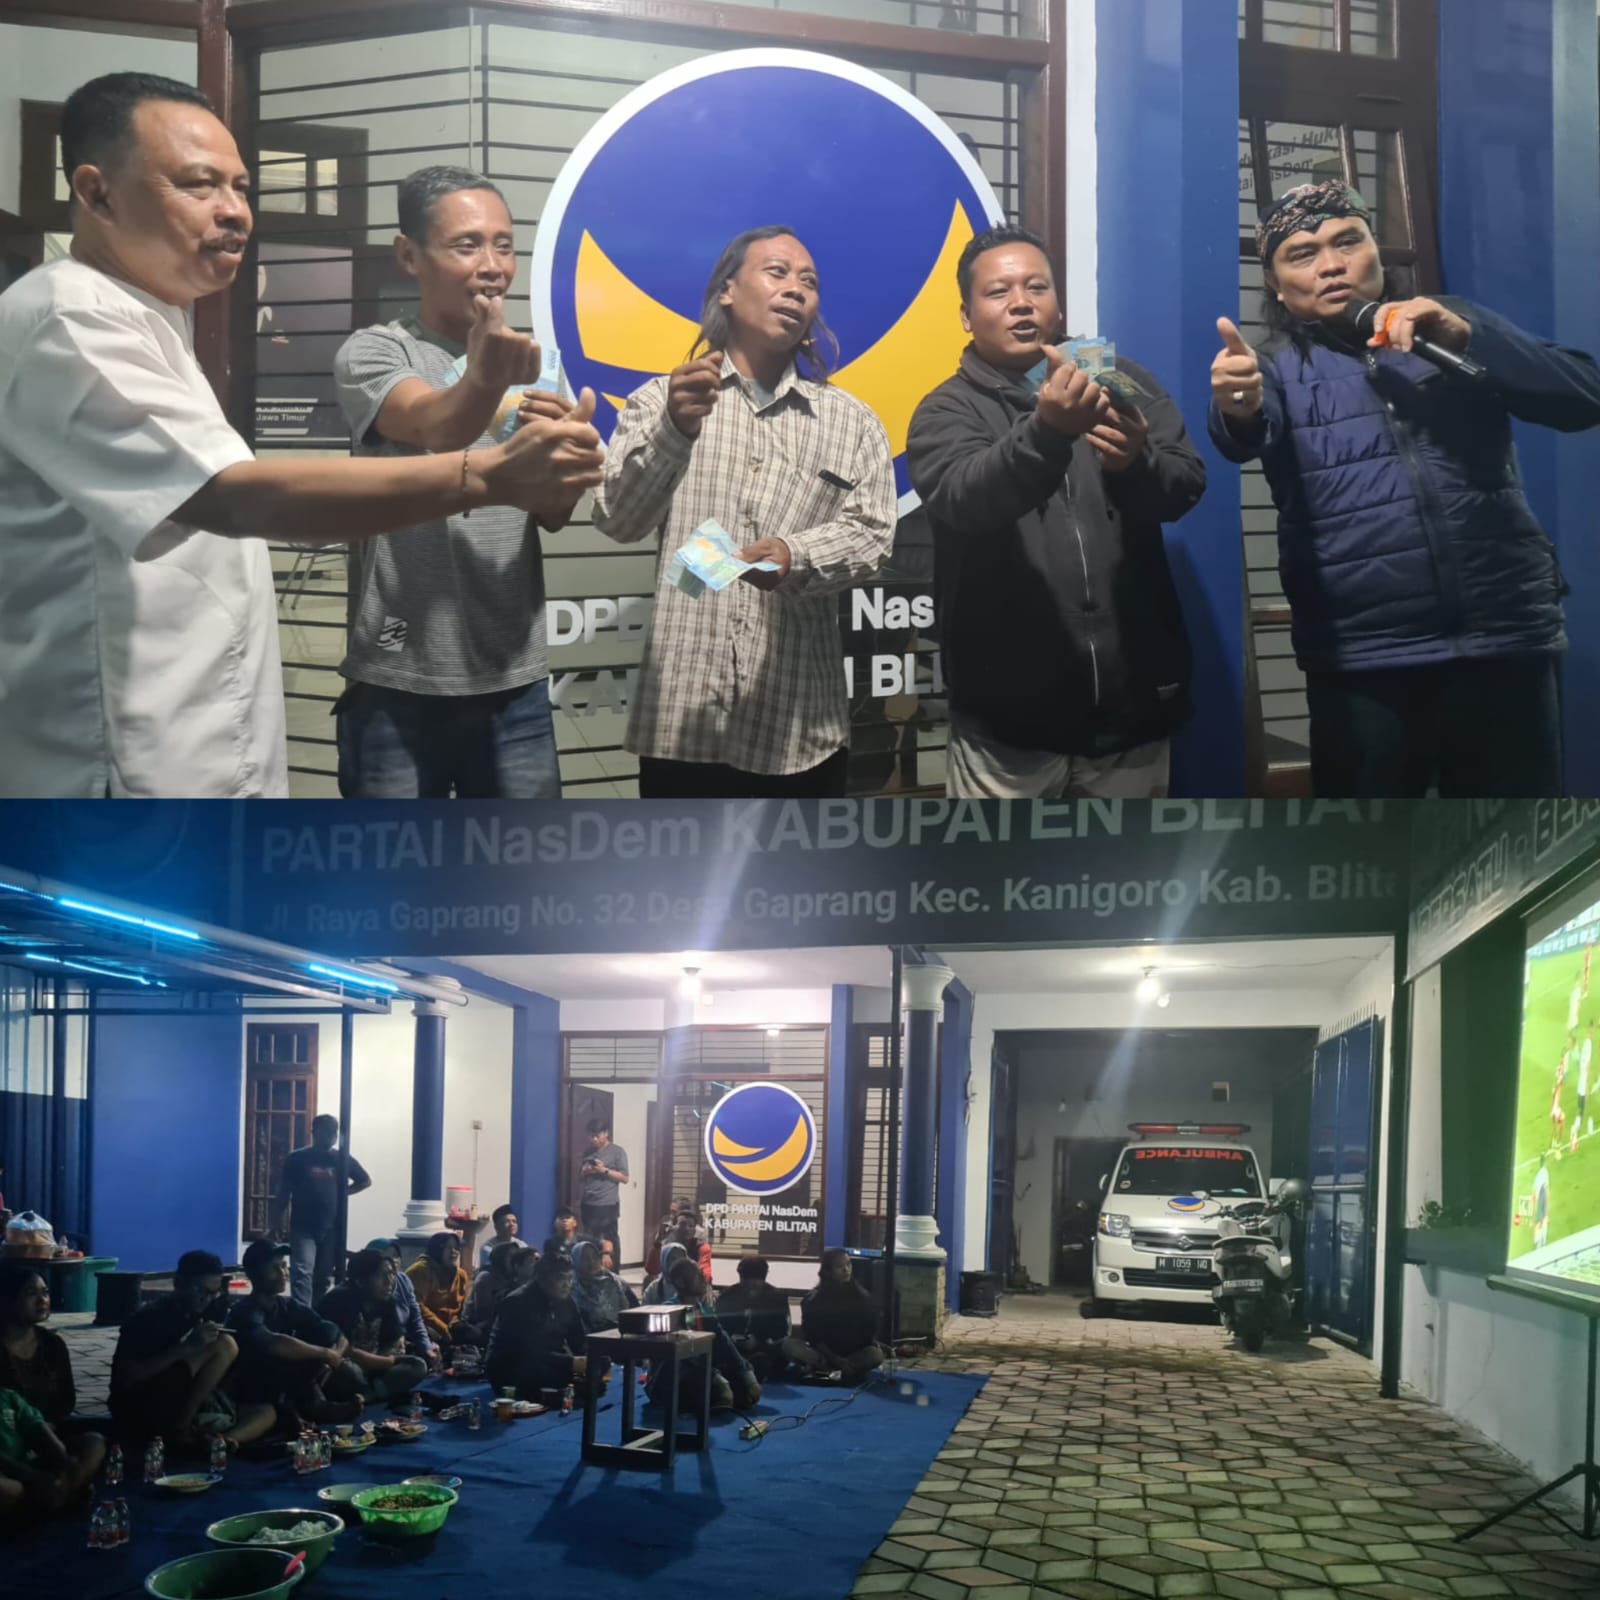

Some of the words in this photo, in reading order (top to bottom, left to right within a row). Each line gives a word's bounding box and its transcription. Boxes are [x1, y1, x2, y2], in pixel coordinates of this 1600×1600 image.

[281, 413, 307, 421] Timur
[852, 587, 935, 631] Nas
[872, 651, 943, 698] BLI
[262, 819, 444, 873] PARTAI
[463, 810, 700, 865] NasDem
[722, 798, 1123, 851] KABUPATEN
[307, 903, 380, 937] Raya
[389, 901, 520, 936] Gaprang
[531, 894, 583, 926] No.
[593, 892, 636, 924] 32
[744, 887, 897, 925] Gaprang
[909, 880, 990, 914] Kec.
[1003, 873, 1187, 917] Kanigoro
[1200, 865, 1292, 905] Kab.
[1308, 861, 1397, 900] Blit
[704, 1218, 773, 1232] KABUPATEN
[775, 1220, 817, 1233] BLITAR
[705, 1202, 728, 1214] DPD
[732, 1203, 769, 1216] PARTAI
[772, 1205, 817, 1217] NasDem
